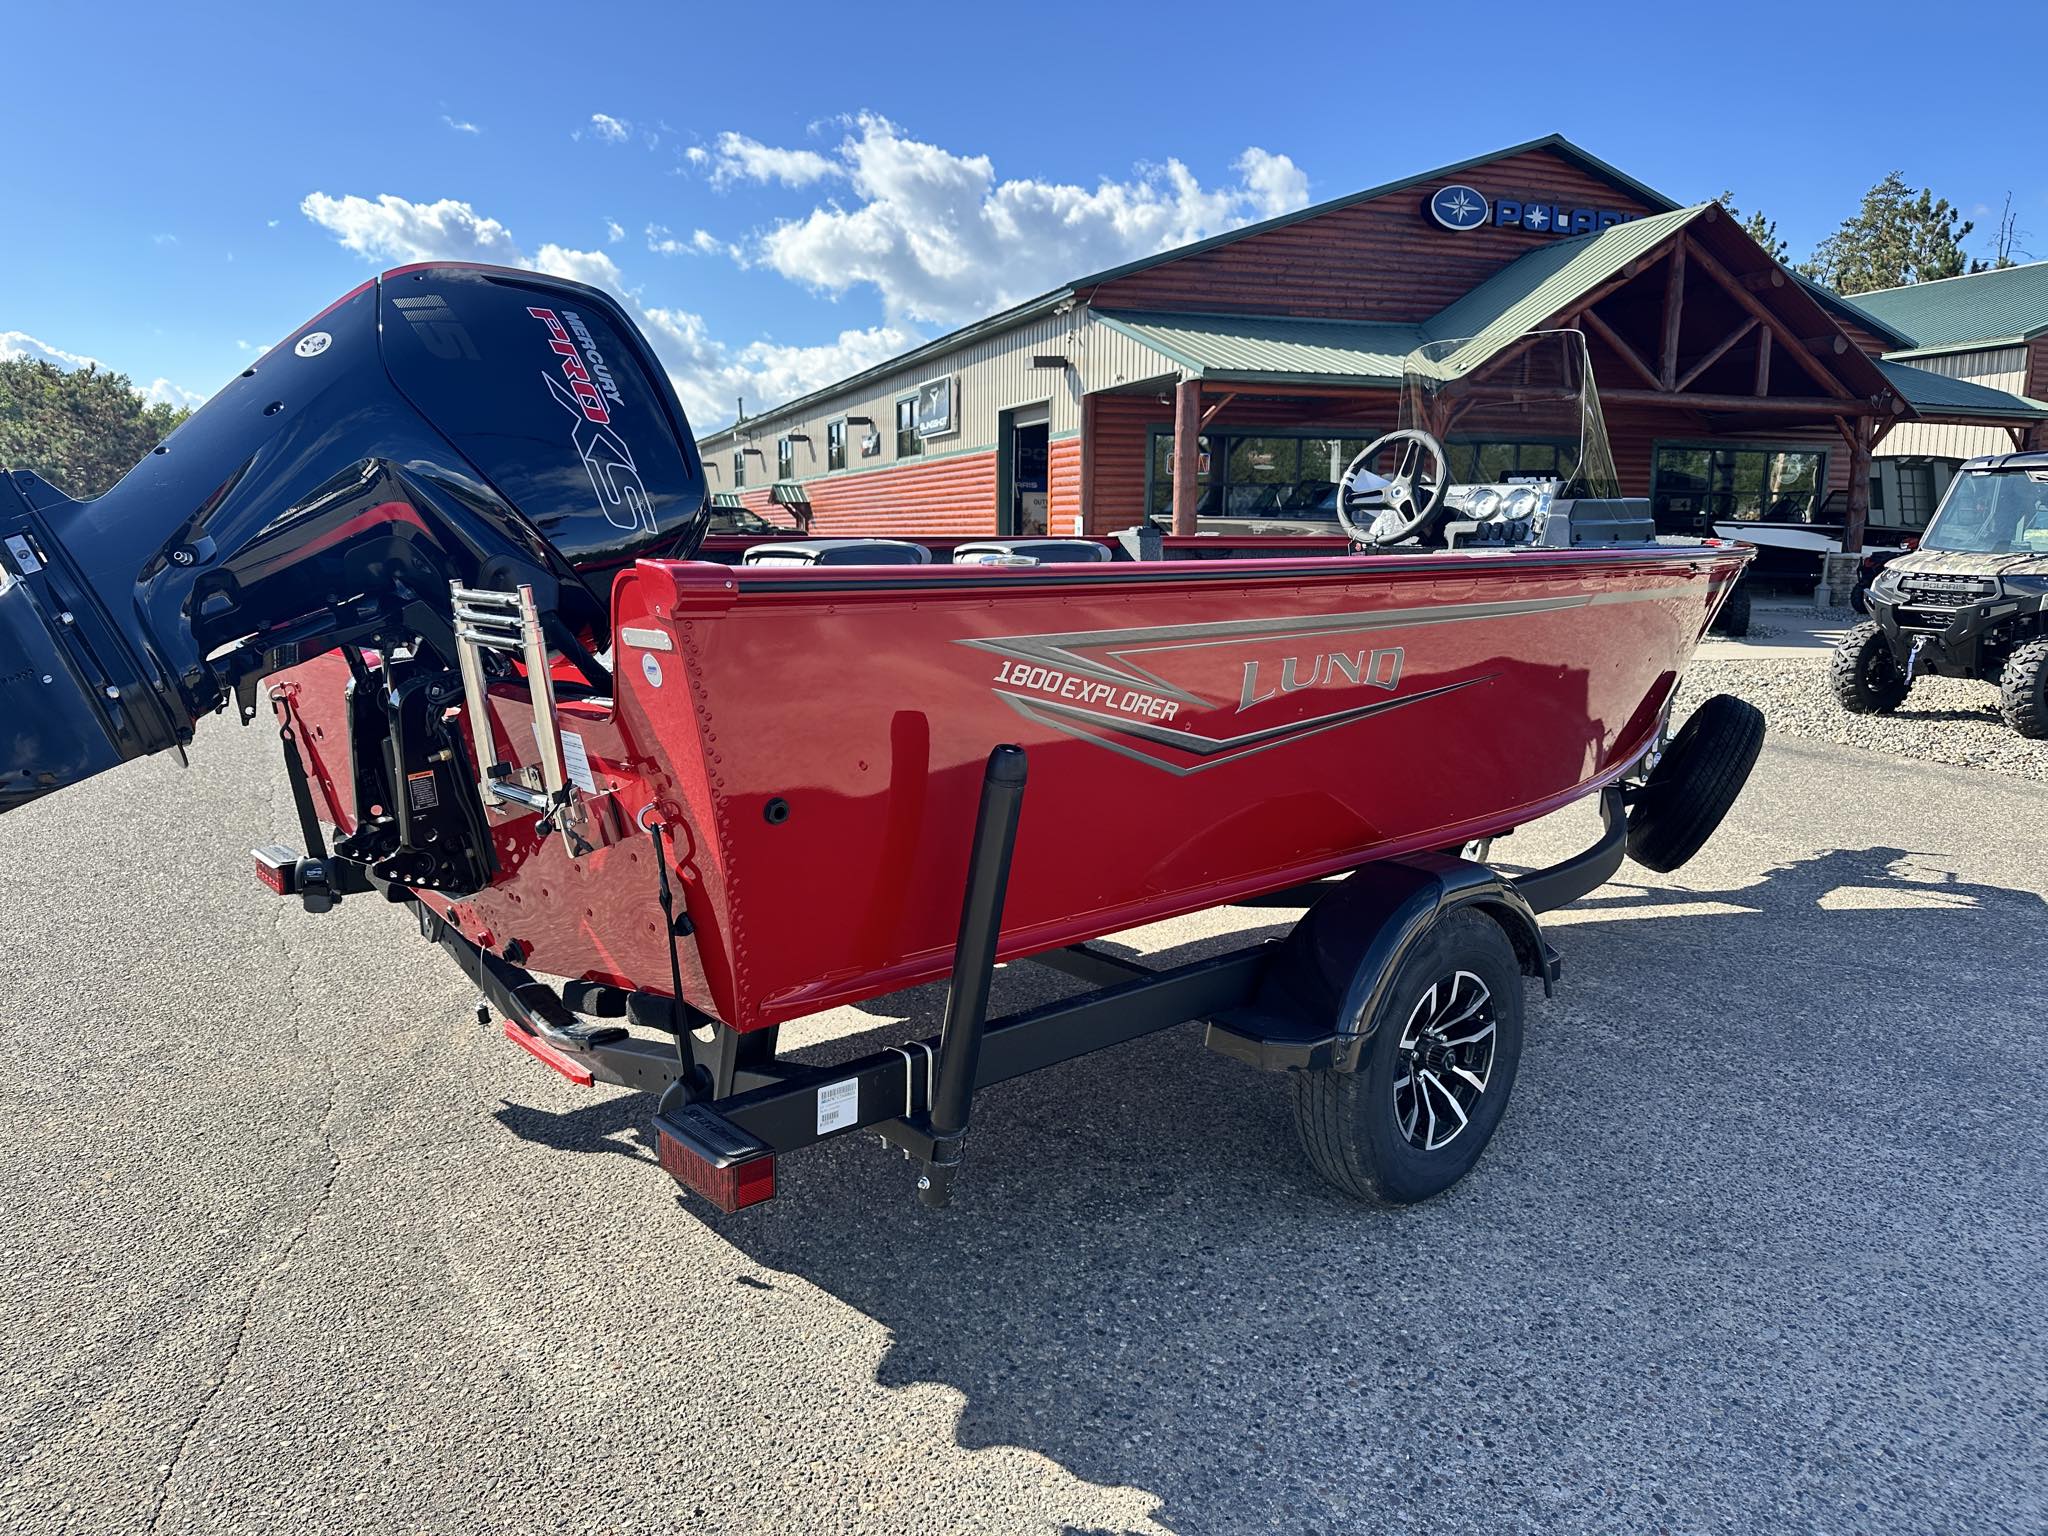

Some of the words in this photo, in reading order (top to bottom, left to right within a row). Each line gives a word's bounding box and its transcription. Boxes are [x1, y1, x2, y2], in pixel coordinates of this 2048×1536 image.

[1496, 200, 1645, 235] POLAR
[526, 306, 611, 424] PRO
[562, 310, 625, 406] MERCURY
[1922, 582, 1967, 591] POLARIS
[992, 660, 1061, 693] 1800
[1061, 678, 1180, 722] EXPLORER
[1234, 646, 1406, 714] LUND
